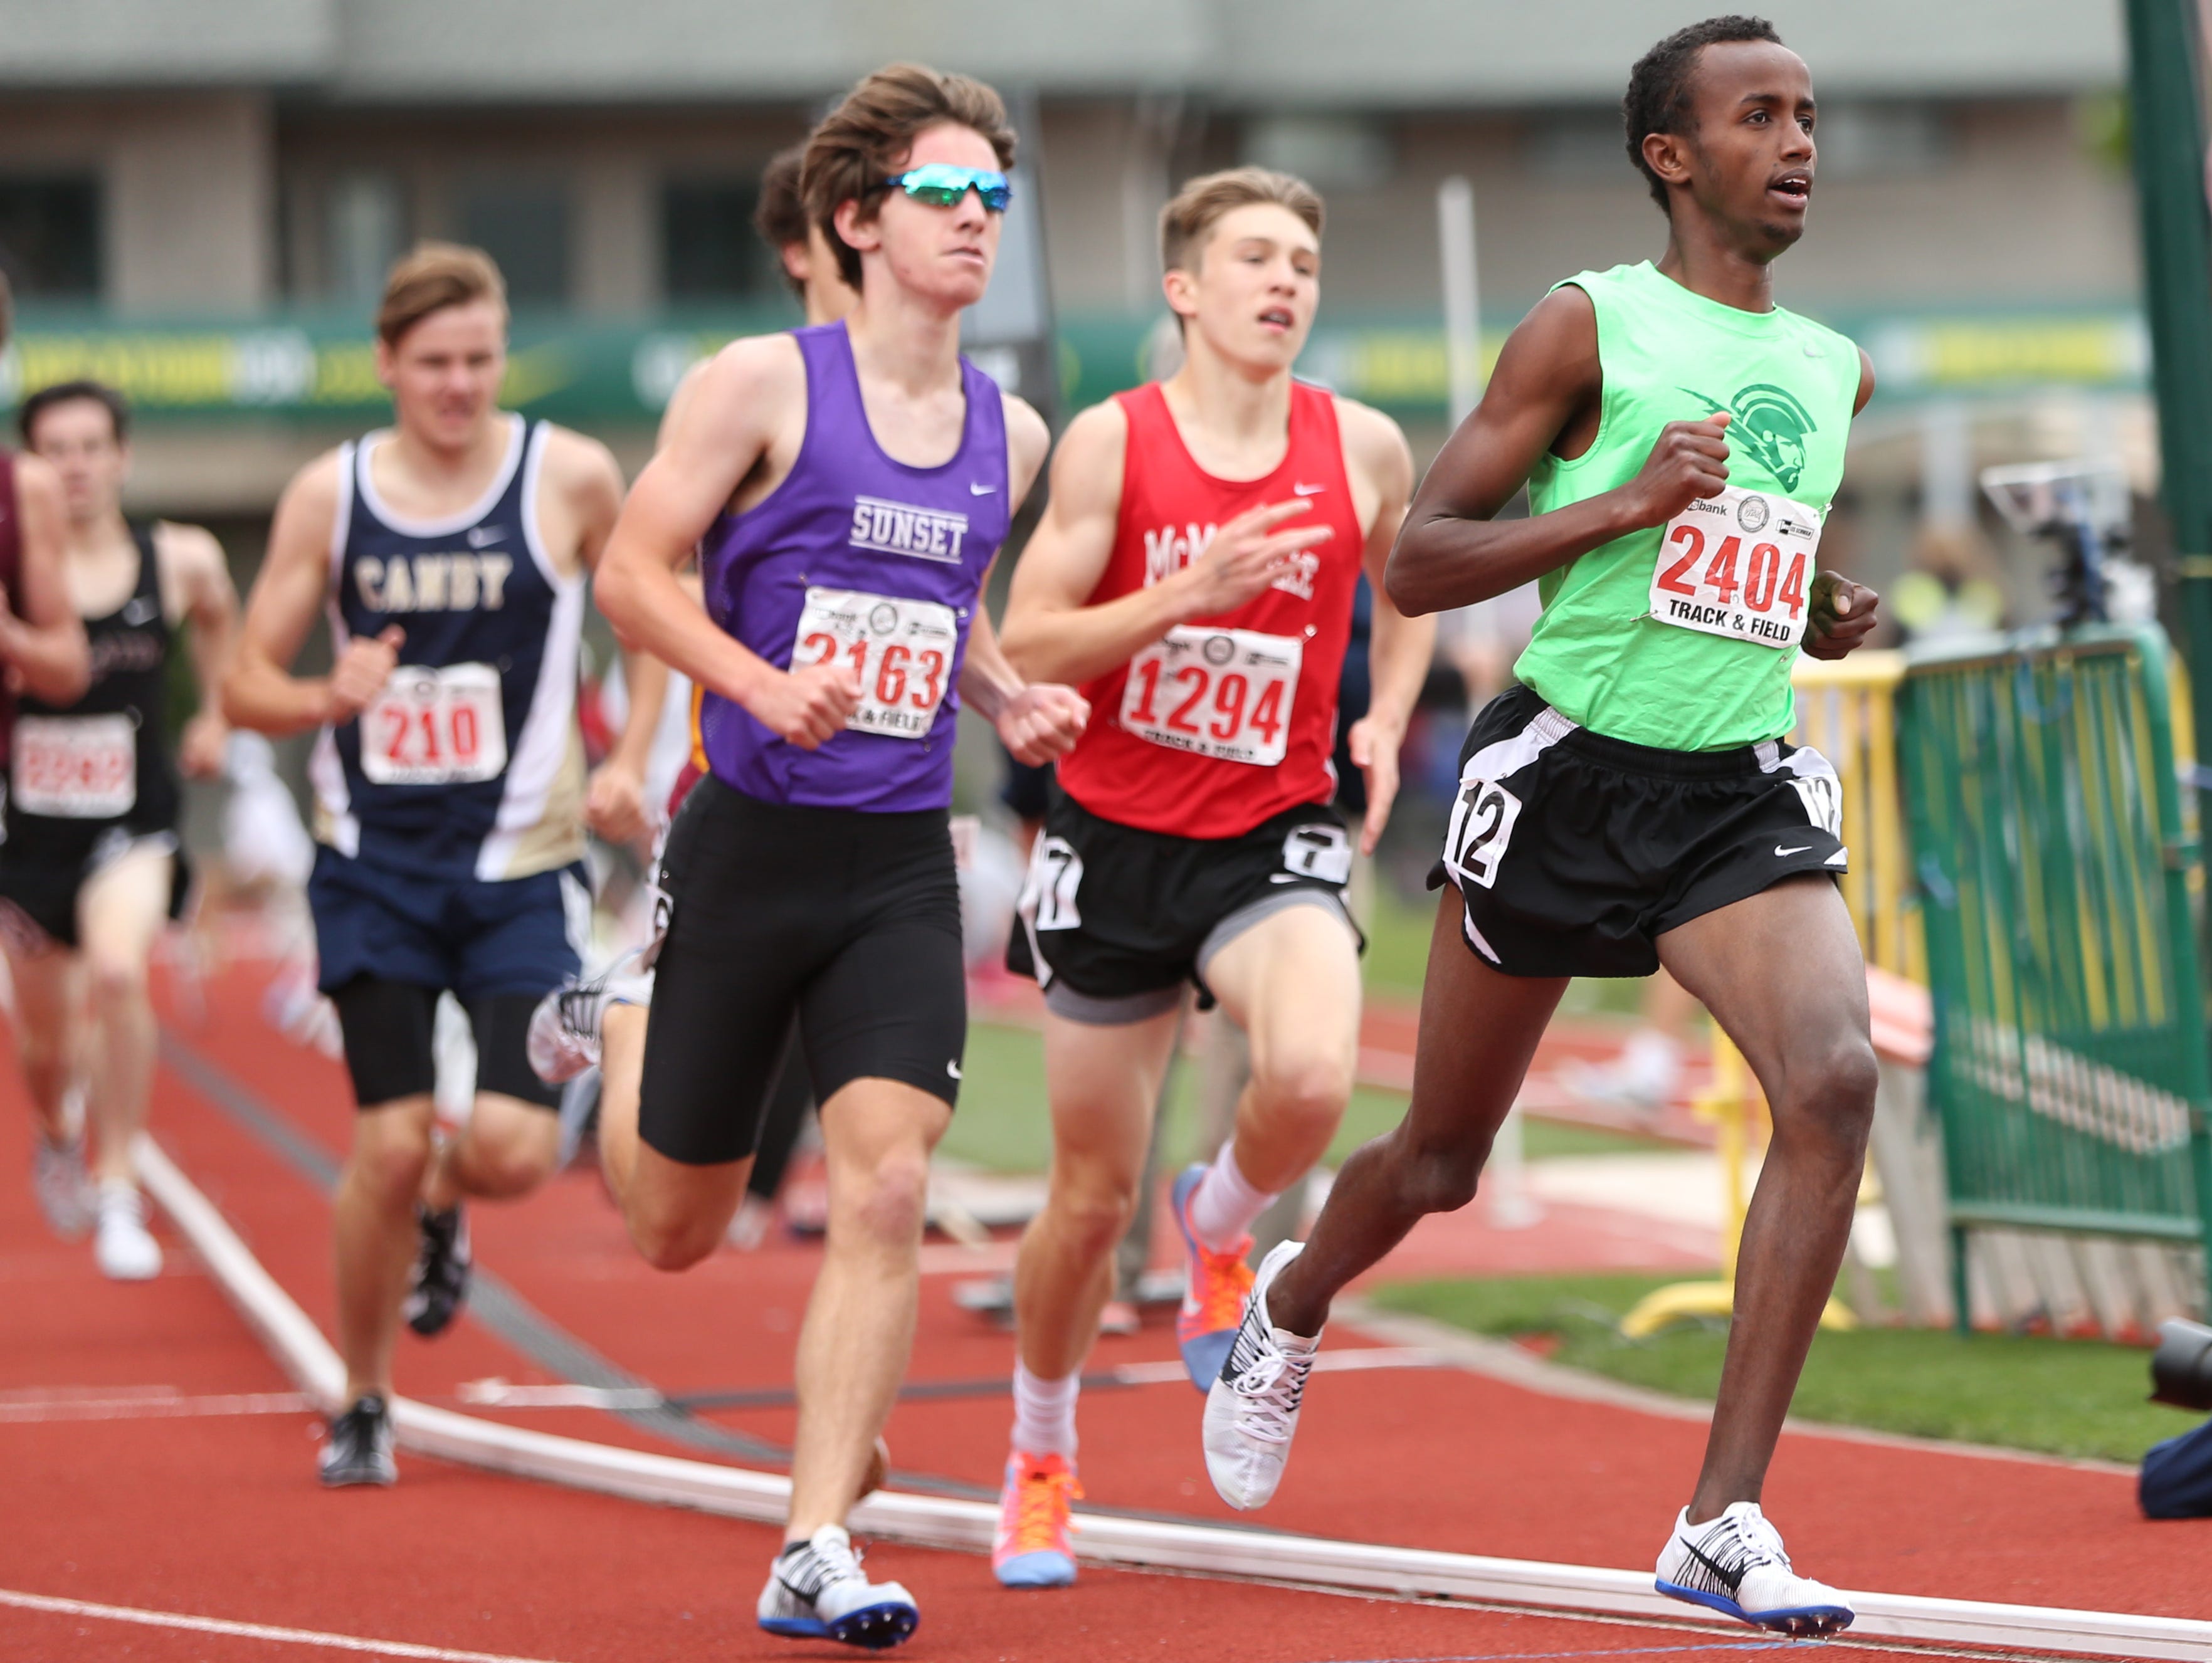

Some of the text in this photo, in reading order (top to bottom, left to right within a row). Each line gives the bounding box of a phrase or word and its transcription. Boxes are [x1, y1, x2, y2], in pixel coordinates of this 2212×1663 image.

[850, 504, 969, 558] SUNSET
[1657, 525, 1806, 620] 2404
[1670, 599, 1790, 641] TRACK & FIELD
[804, 632, 943, 709] 2163
[1130, 659, 1285, 744] 1294
[381, 703, 480, 768] 210
[1454, 781, 1505, 879] 12
